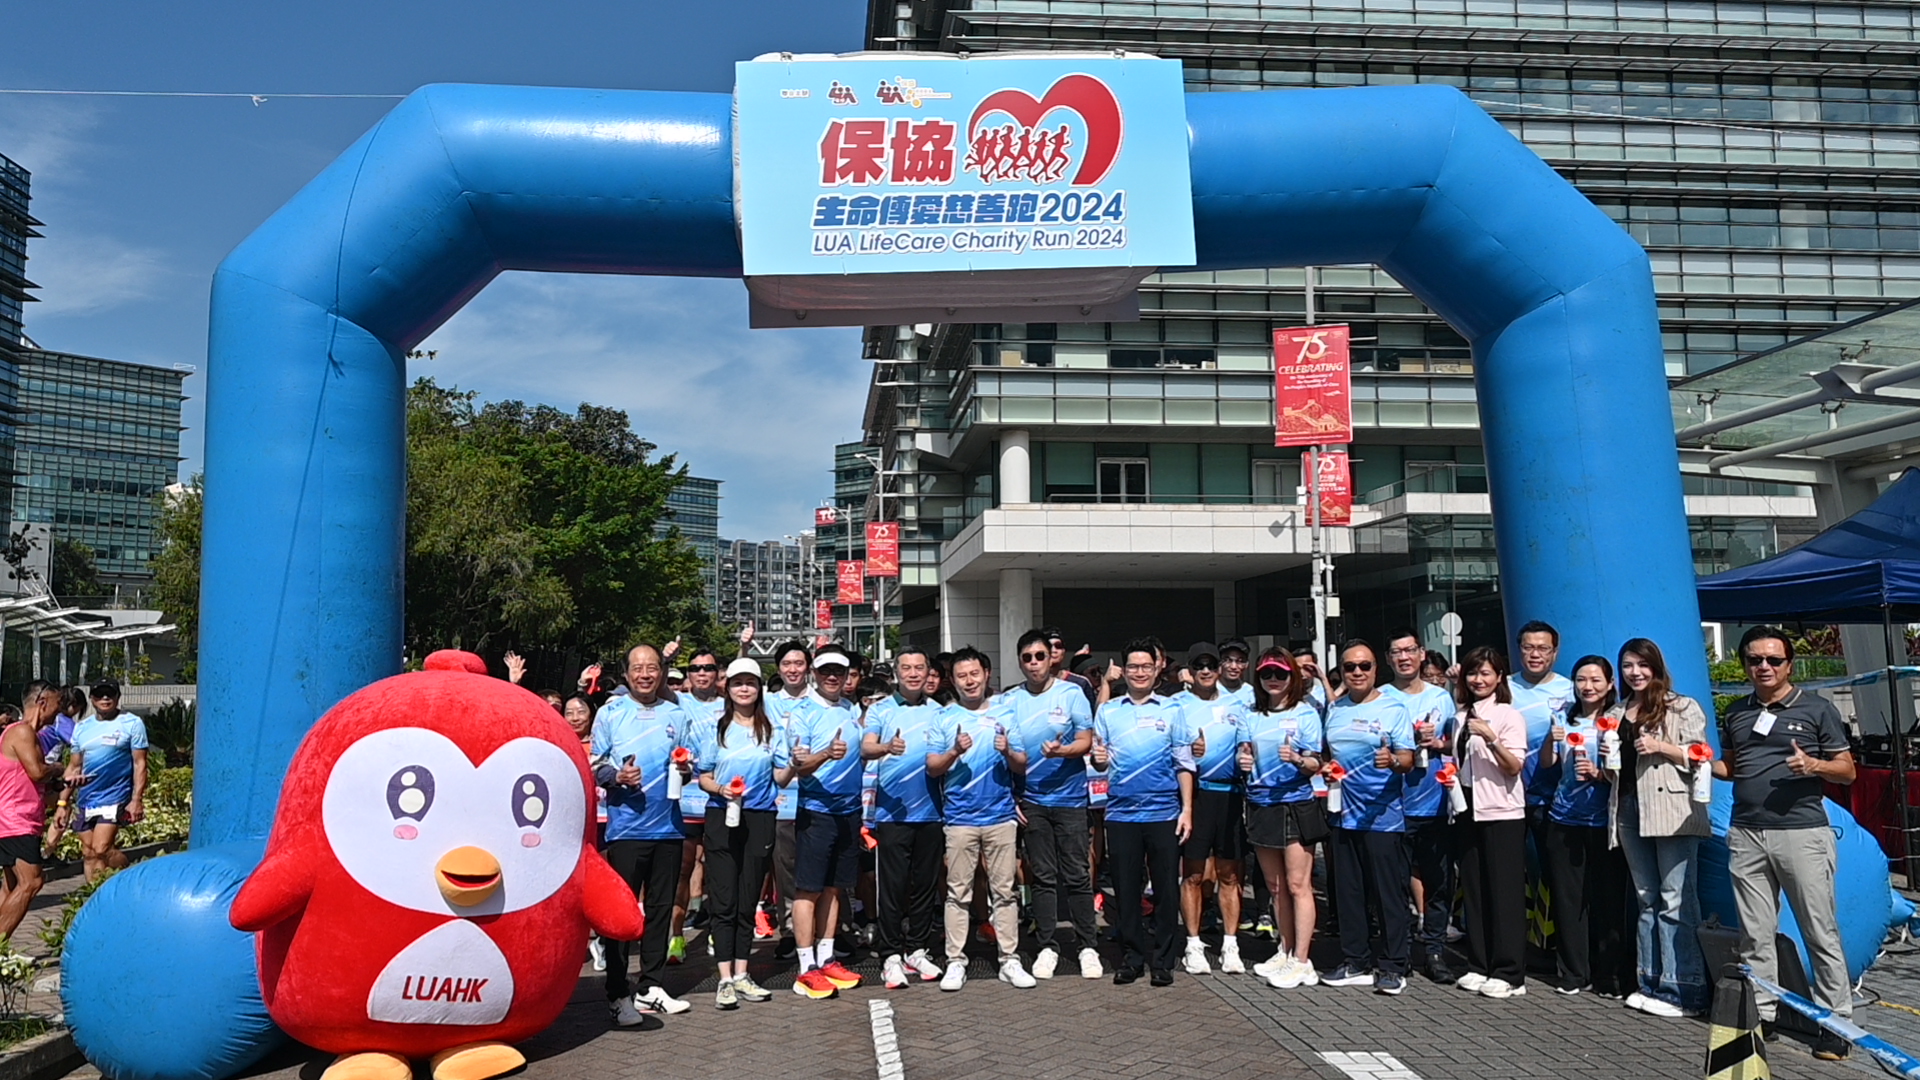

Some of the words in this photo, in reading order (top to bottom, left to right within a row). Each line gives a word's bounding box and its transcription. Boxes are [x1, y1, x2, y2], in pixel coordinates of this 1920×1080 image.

[820, 120, 955, 184] 保協
[814, 234, 852, 252] LUA
[860, 233, 945, 251] LifeCare
[952, 230, 1027, 252] Charity
[1032, 230, 1070, 247] Run
[1076, 228, 1123, 246] 2024
[1291, 331, 1329, 364] 75
[1278, 362, 1344, 375] CELEBRATING
[1317, 455, 1336, 475] 75
[873, 524, 890, 539] 75
[402, 975, 489, 1003] LUAHK
